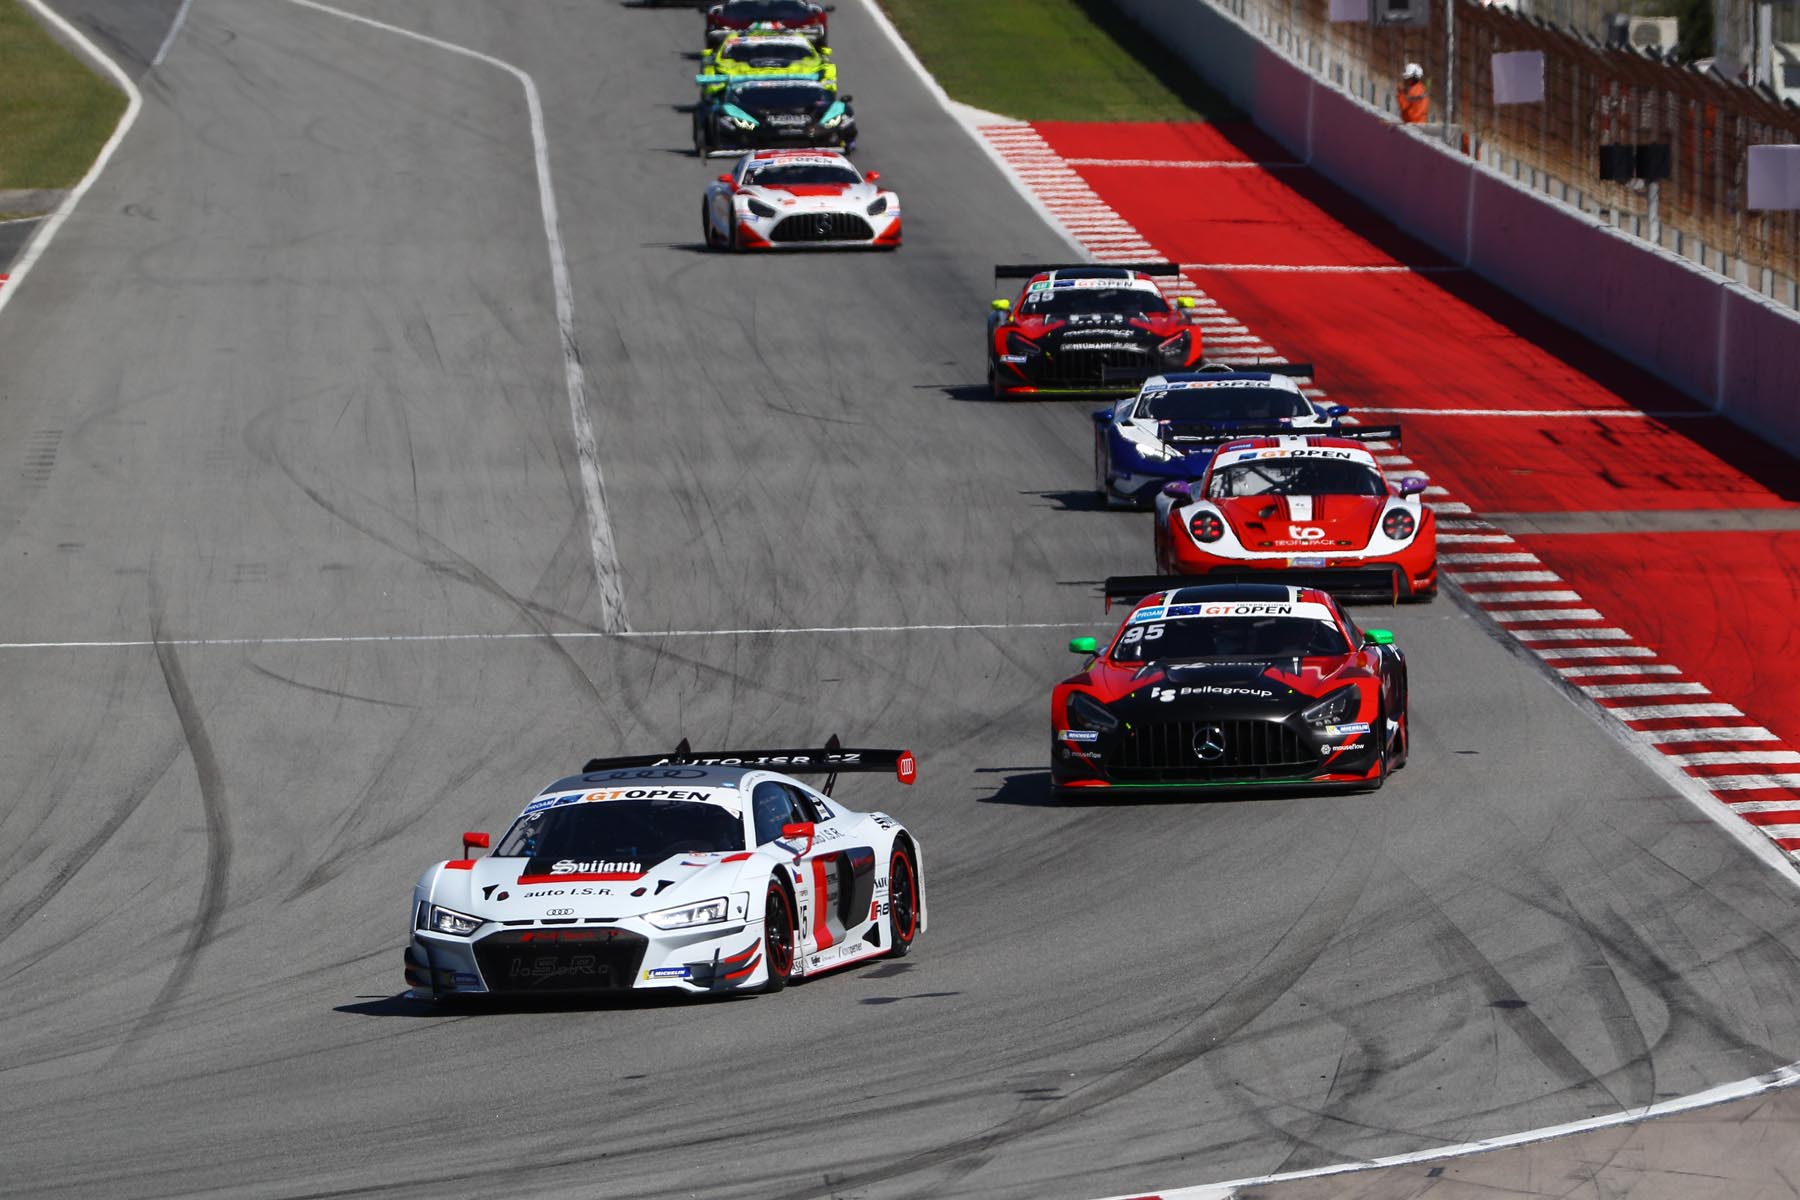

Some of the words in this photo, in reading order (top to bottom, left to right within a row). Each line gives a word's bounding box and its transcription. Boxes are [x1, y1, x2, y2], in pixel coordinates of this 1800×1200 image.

[1123, 623, 1166, 644] 95
[1180, 686, 1273, 698] Bellagroup
[1332, 743, 1365, 751] mouseflow
[523, 889, 565, 898] auto
[570, 887, 615, 897] I.S.R.
